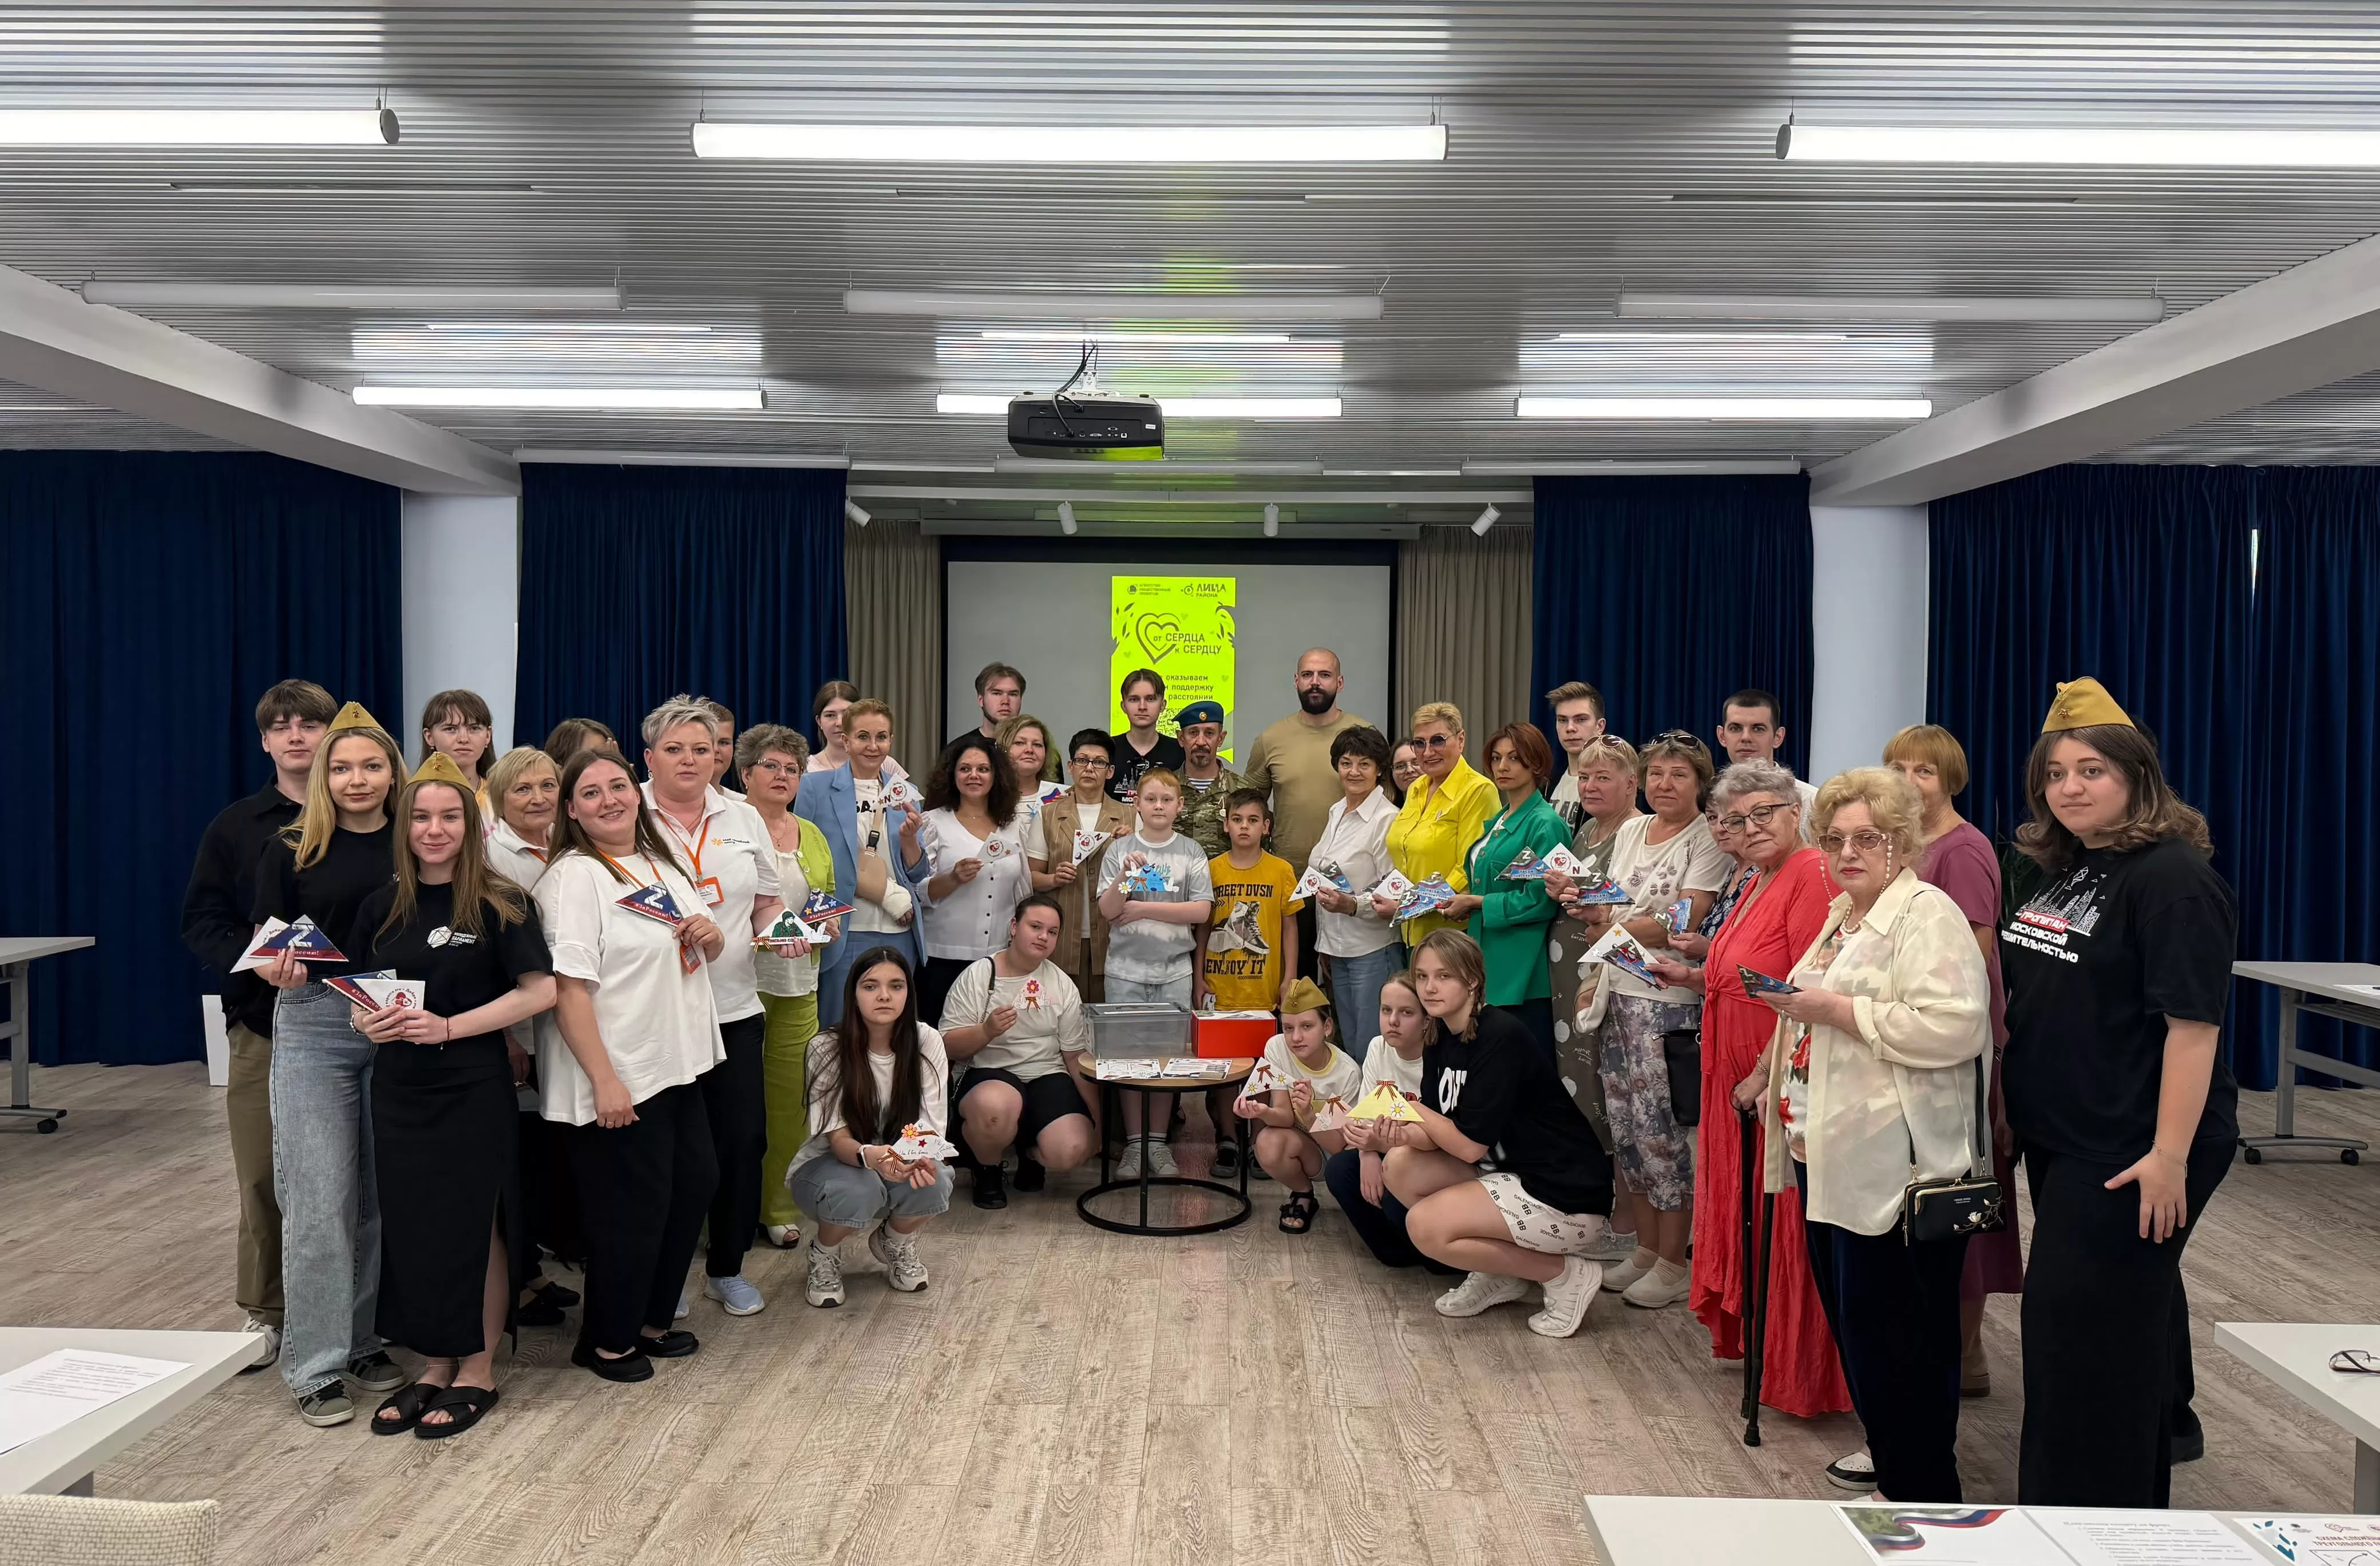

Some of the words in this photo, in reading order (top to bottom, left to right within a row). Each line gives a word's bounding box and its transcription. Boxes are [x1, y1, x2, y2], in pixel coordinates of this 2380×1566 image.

[1197, 584, 1226, 593] ЛИЦА
[1166, 633, 1205, 643] СЕРДЦА
[1183, 645, 1222, 656] СЕРДЦУ
[1522, 850, 1531, 859] Z
[1592, 873, 1602, 882] Z
[1212, 883, 1244, 899] TREET
[1245, 883, 1274, 898] DVSN
[1206, 958, 1247, 975] ENJOY
[1250, 958, 1266, 975] IT
